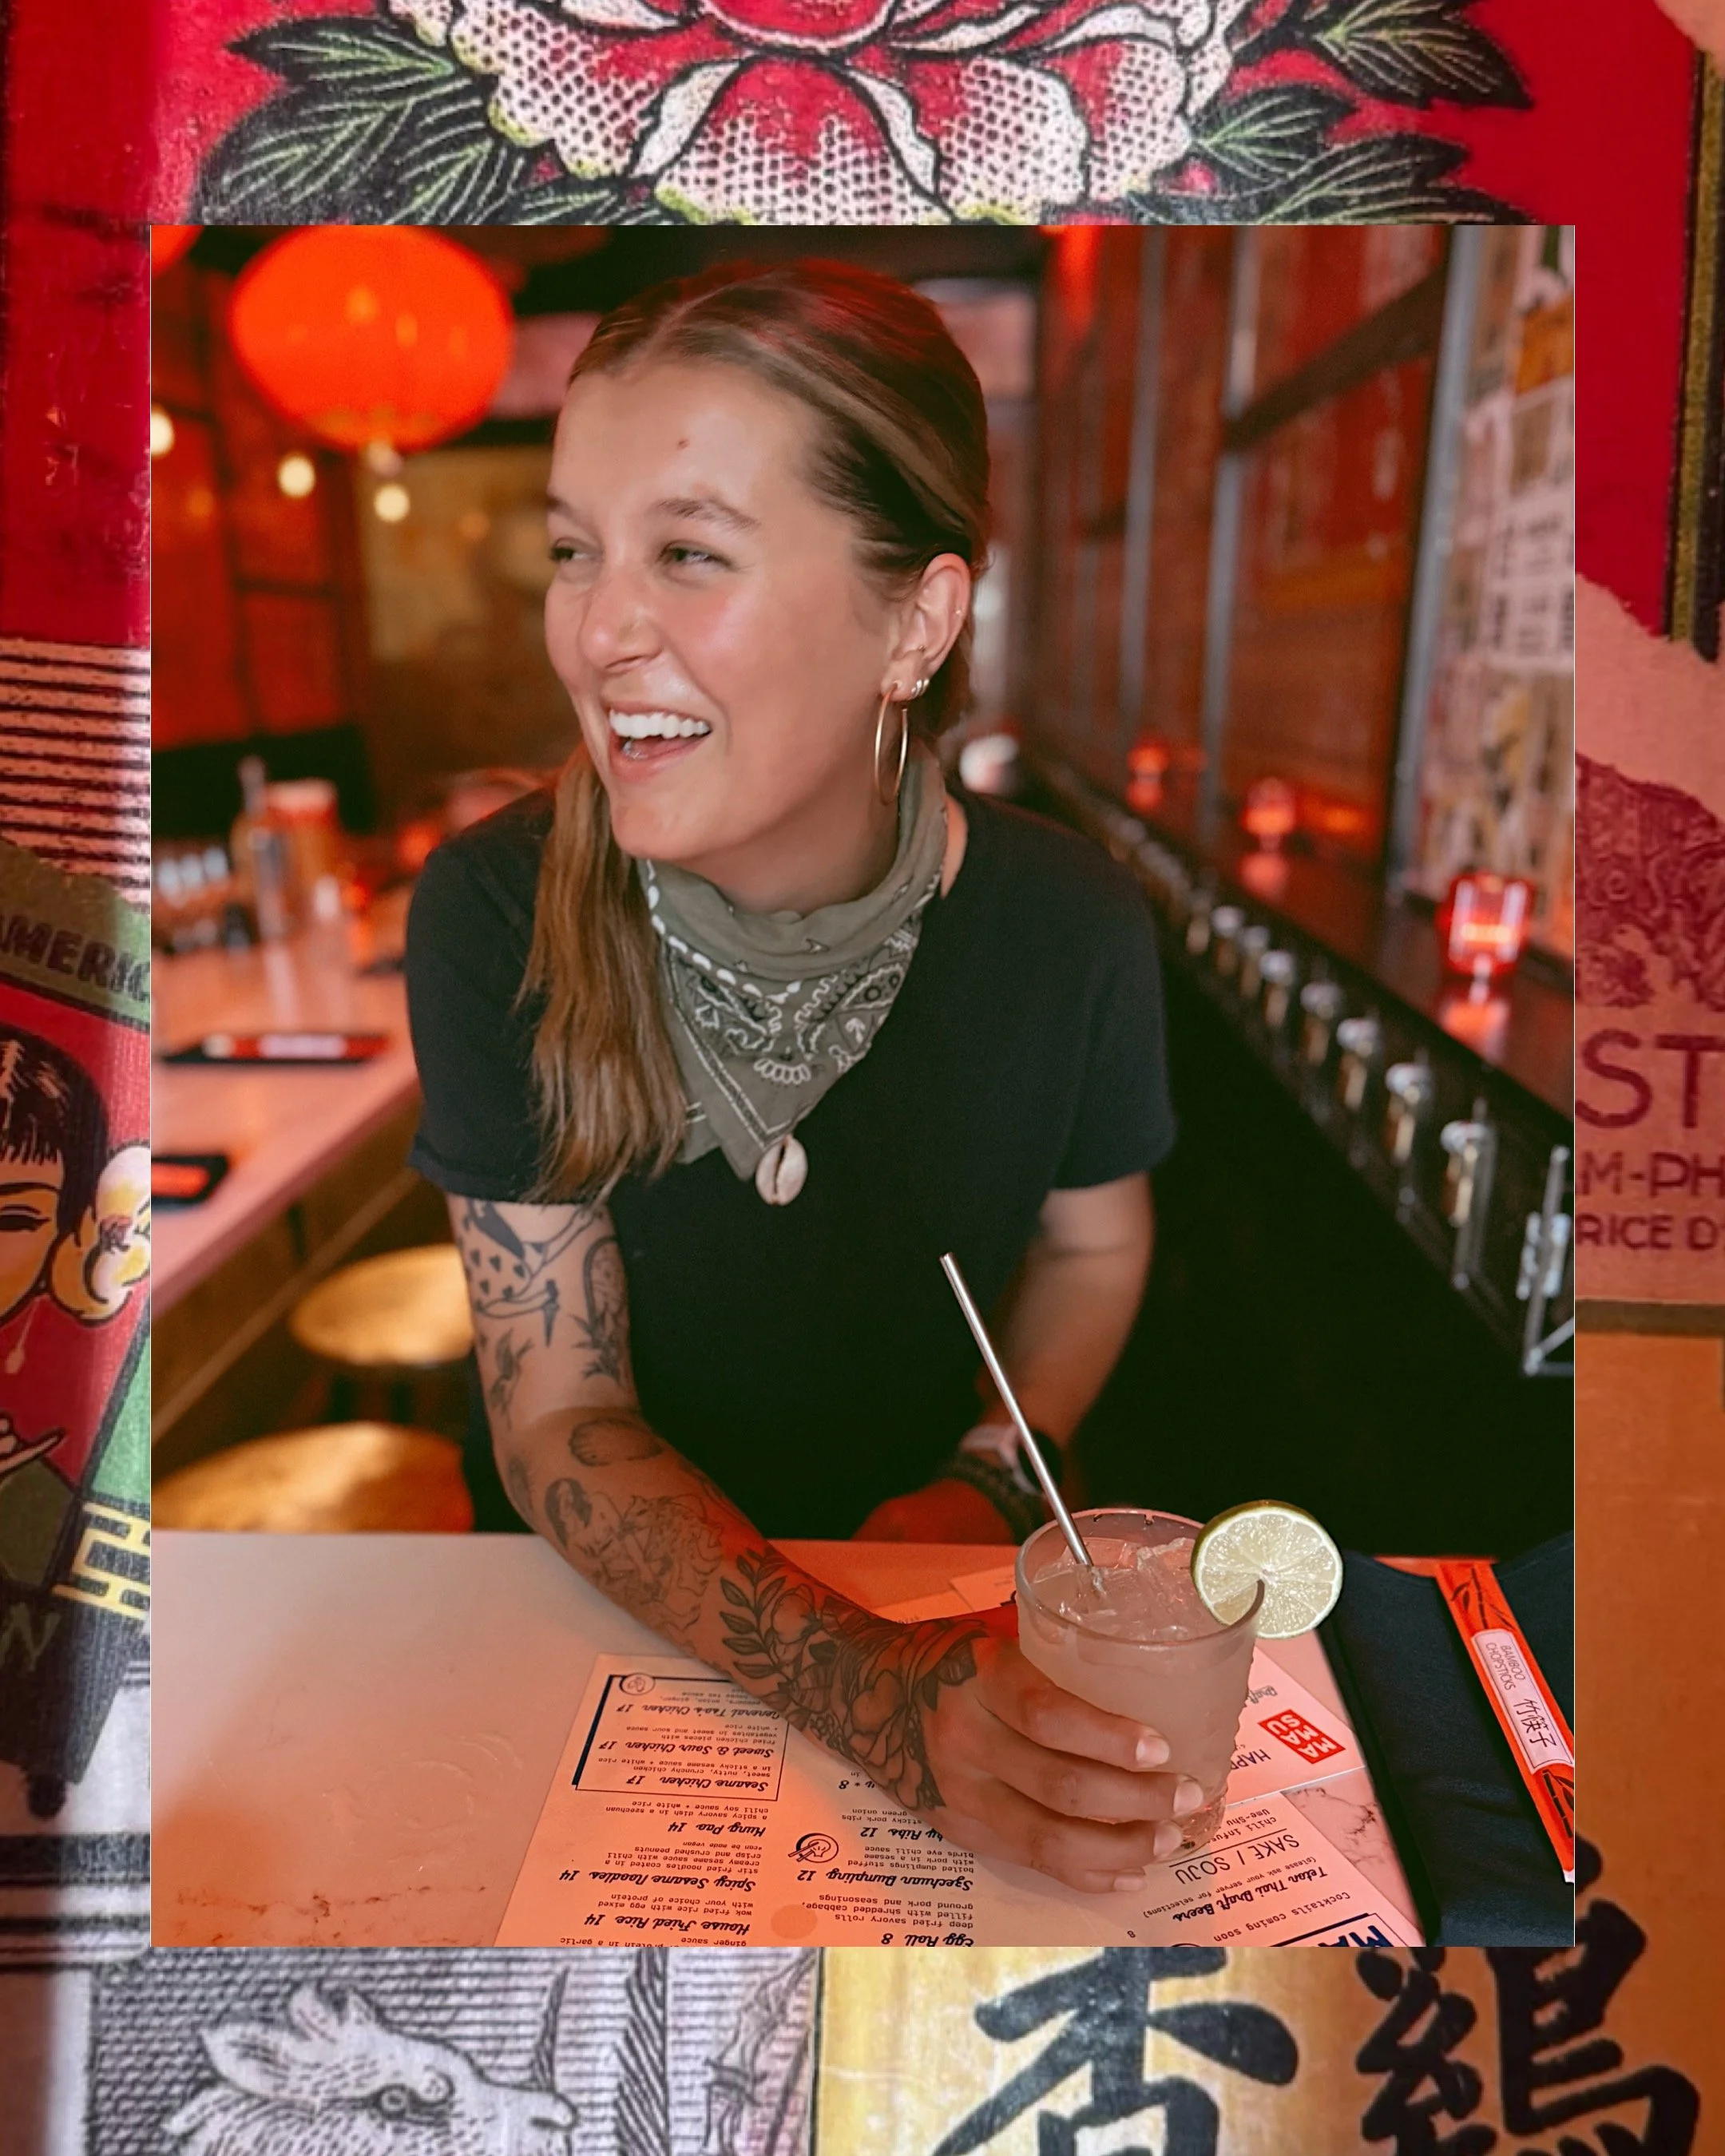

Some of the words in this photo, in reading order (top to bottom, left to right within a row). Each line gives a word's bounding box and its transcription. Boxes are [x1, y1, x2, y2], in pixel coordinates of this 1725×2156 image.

[1576, 1213, 1673, 1249] RICE
[1485, 1642, 1517, 1691] CHOPSTICKS
[1500, 1645, 1526, 1681] BAMBOO
[616, 1704, 634, 1713] 17
[641, 1705, 690, 1715] Chicken
[692, 1707, 726, 1717] Tso's
[730, 1709, 779, 1719] General
[1267, 1714, 1301, 1736] SU
[1513, 1698, 1557, 1748] 竹筷子
[1280, 1725, 1319, 1745] MA
[598, 1741, 617, 1750] 17
[625, 1742, 676, 1753] Chicken
[678, 1744, 712, 1754] Sour
[716, 1746, 730, 1755] &
[1297, 1738, 1338, 1758] MA
[732, 1747, 774, 1758] Sweet
[621, 1758, 644, 1767] white
[719, 1763, 748, 1772] sticky
[625, 1775, 645, 1785] 17
[659, 1777, 712, 1789] Chicken
[714, 1780, 768, 1792] Sesame
[839, 1780, 850, 1789] 8
[1225, 1809, 1270, 1827] Ume-Shu
[667, 1821, 688, 1833] 14
[695, 1823, 724, 1835] Pao
[727, 1822, 766, 1837] Kung
[1245, 1817, 1277, 1832] chili
[860, 1827, 878, 1837] 12
[887, 1829, 922, 1841] Ribs
[1247, 1834, 1299, 1860] SAKE
[889, 1862, 937, 1871] dumplings
[1284, 1857, 1316, 1870] (please
[558, 1869, 580, 1881] 14
[797, 1870, 816, 1881] 12
[1174, 1857, 1231, 1885] SOJU
[1287, 1866, 1328, 1885] Teton
[588, 1872, 648, 1885] Noodles
[650, 1875, 709, 1889] Sesame
[712, 1875, 755, 1892] Spicy
[825, 1869, 897, 1887] Dumpling
[899, 1877, 974, 1891] Szechuan
[1246, 1873, 1265, 1883] your
[1215, 1881, 1243, 1893] server
[1255, 1879, 1288, 1897] Thai
[610, 1894, 648, 1904] protein
[818, 1895, 878, 1904] seasonings
[1215, 1890, 1255, 1911] Draft
[1291, 1892, 1350, 1915] Cocktails
[801, 1902, 847, 1912] cabbage,
[852, 1906, 901, 1915] shredded
[1142, 1897, 1194, 1918] selections)
[1172, 1903, 1215, 1921] Beers
[583, 1913, 605, 1925] 14
[614, 1916, 650, 1928] Rice
[937, 1912, 973, 1920] filled
[1245, 1913, 1287, 1931] coming
[652, 1918, 697, 1932] Fried
[700, 1921, 750, 1936] House
[912, 1919, 942, 1928] fried
[948, 1920, 973, 1929] deep
[880, 1933, 894, 1944] 8
[1126, 1929, 1136, 1939] 8
[1212, 1928, 1242, 1942] soon
[903, 1935, 939, 1948] Roll
